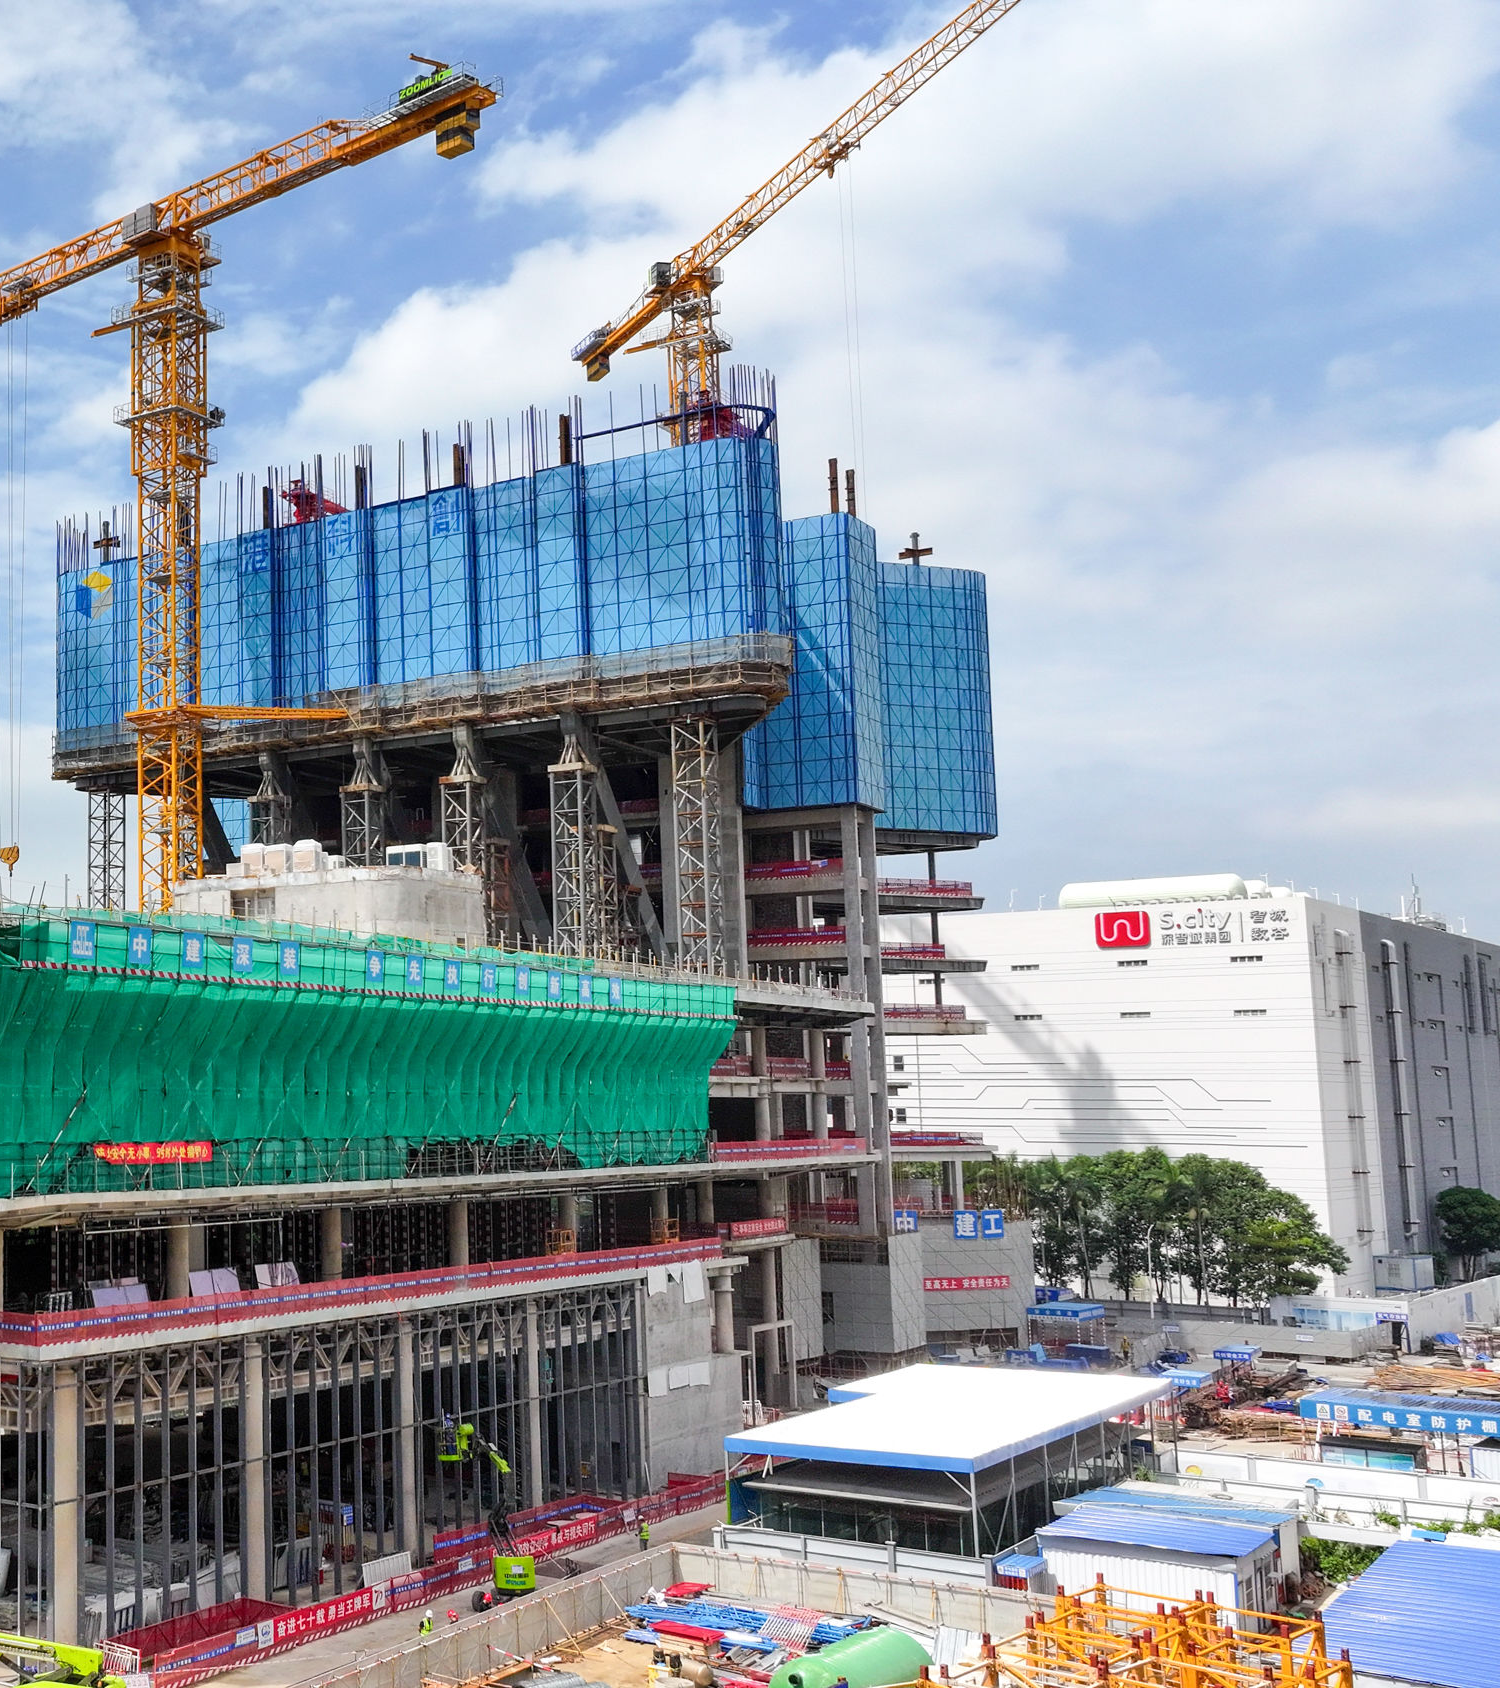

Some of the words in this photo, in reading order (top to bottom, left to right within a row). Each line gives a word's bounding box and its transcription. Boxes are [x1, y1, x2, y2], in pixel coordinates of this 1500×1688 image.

[1160, 908, 1231, 931] S.city
[1251, 909, 1289, 925] 智城
[1251, 927, 1290, 942] 数谷
[132, 933, 297, 969] 中建深装
[369, 955, 621, 1001] 争先执行创新高效
[955, 1212, 1002, 1236] 建工
[925, 1280, 958, 1290] 至高无上
[1357, 1408, 1498, 1434] 配电室防护棚
[277, 1608, 325, 1637] 奋进七十载
[327, 1592, 371, 1621] 勇当王牌军
